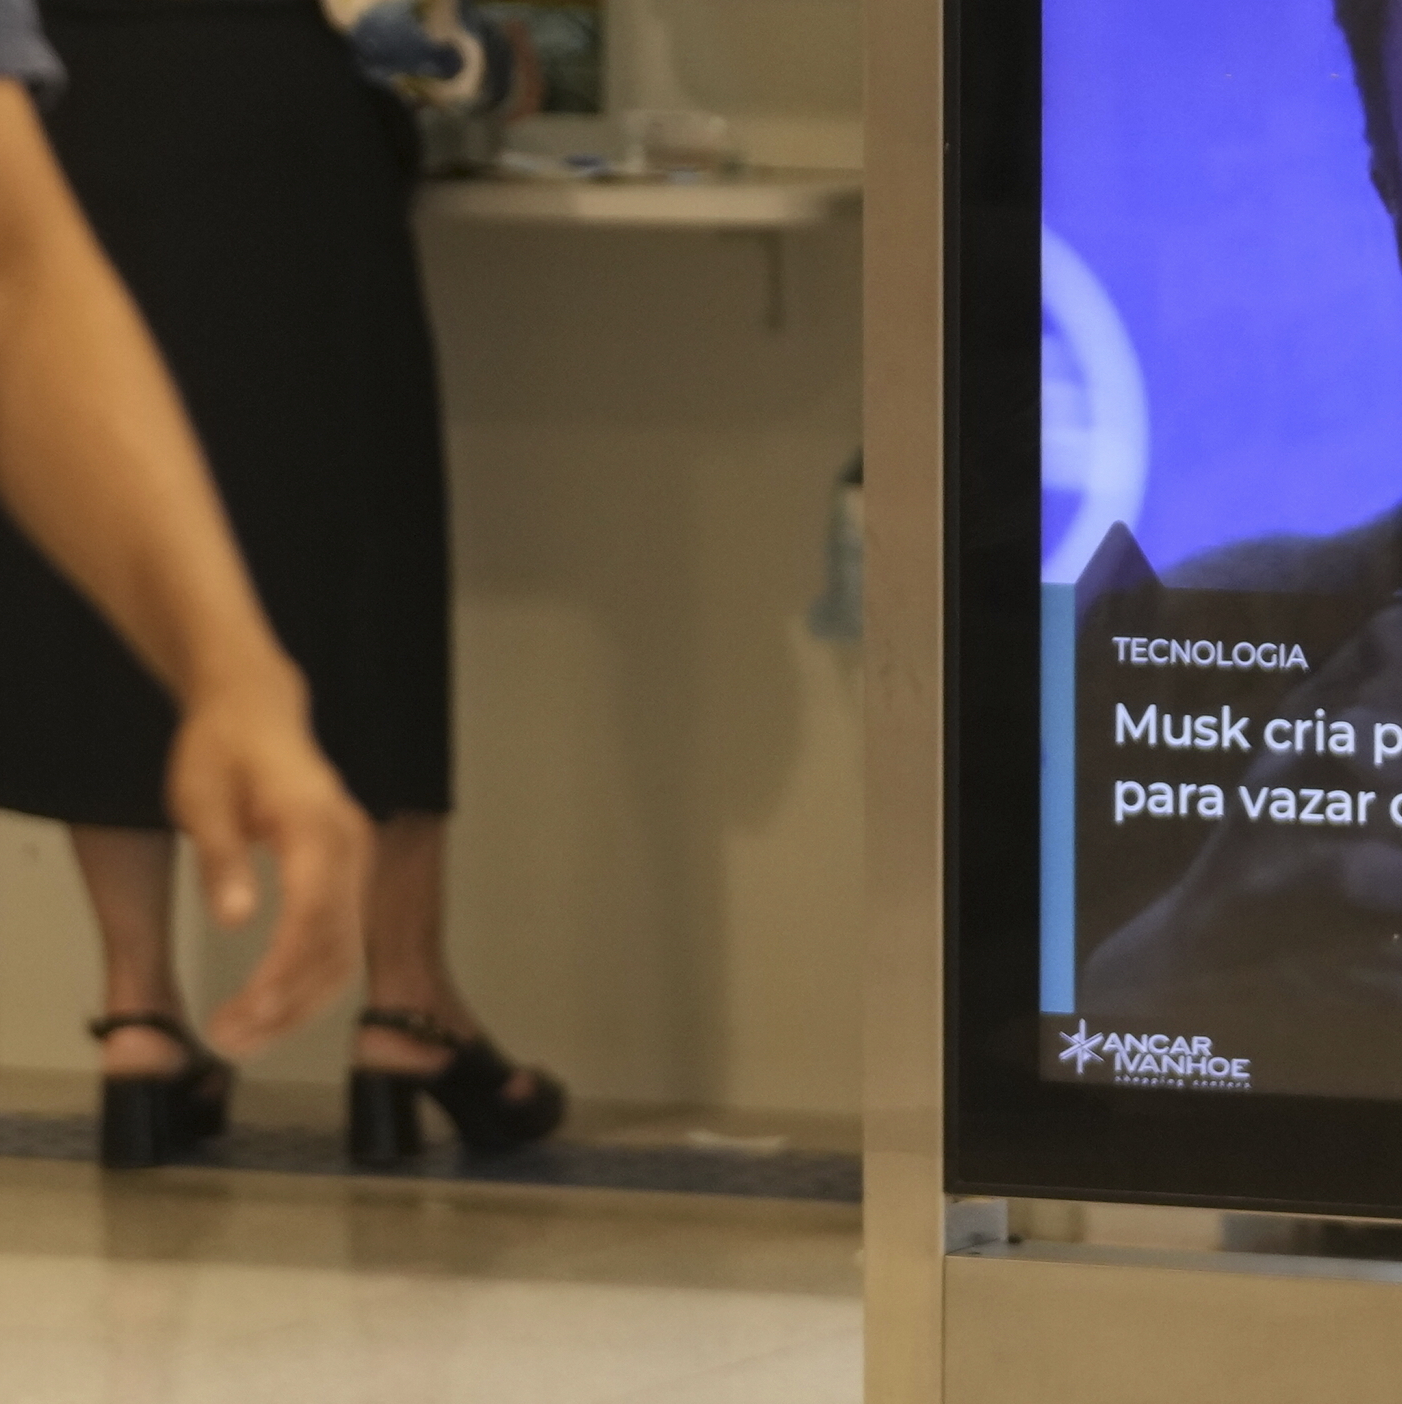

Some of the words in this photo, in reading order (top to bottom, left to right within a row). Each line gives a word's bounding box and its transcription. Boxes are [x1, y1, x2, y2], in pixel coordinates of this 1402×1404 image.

[1112, 636, 1310, 671] TECNOLOGIA
[1115, 702, 1252, 751] Musk
[1263, 707, 1357, 756] cria
[1114, 780, 1225, 824] para
[1238, 784, 1377, 826] vazar
[1102, 1031, 1214, 1057] ANCAR
[1114, 1052, 1252, 1079] IVANHOE
